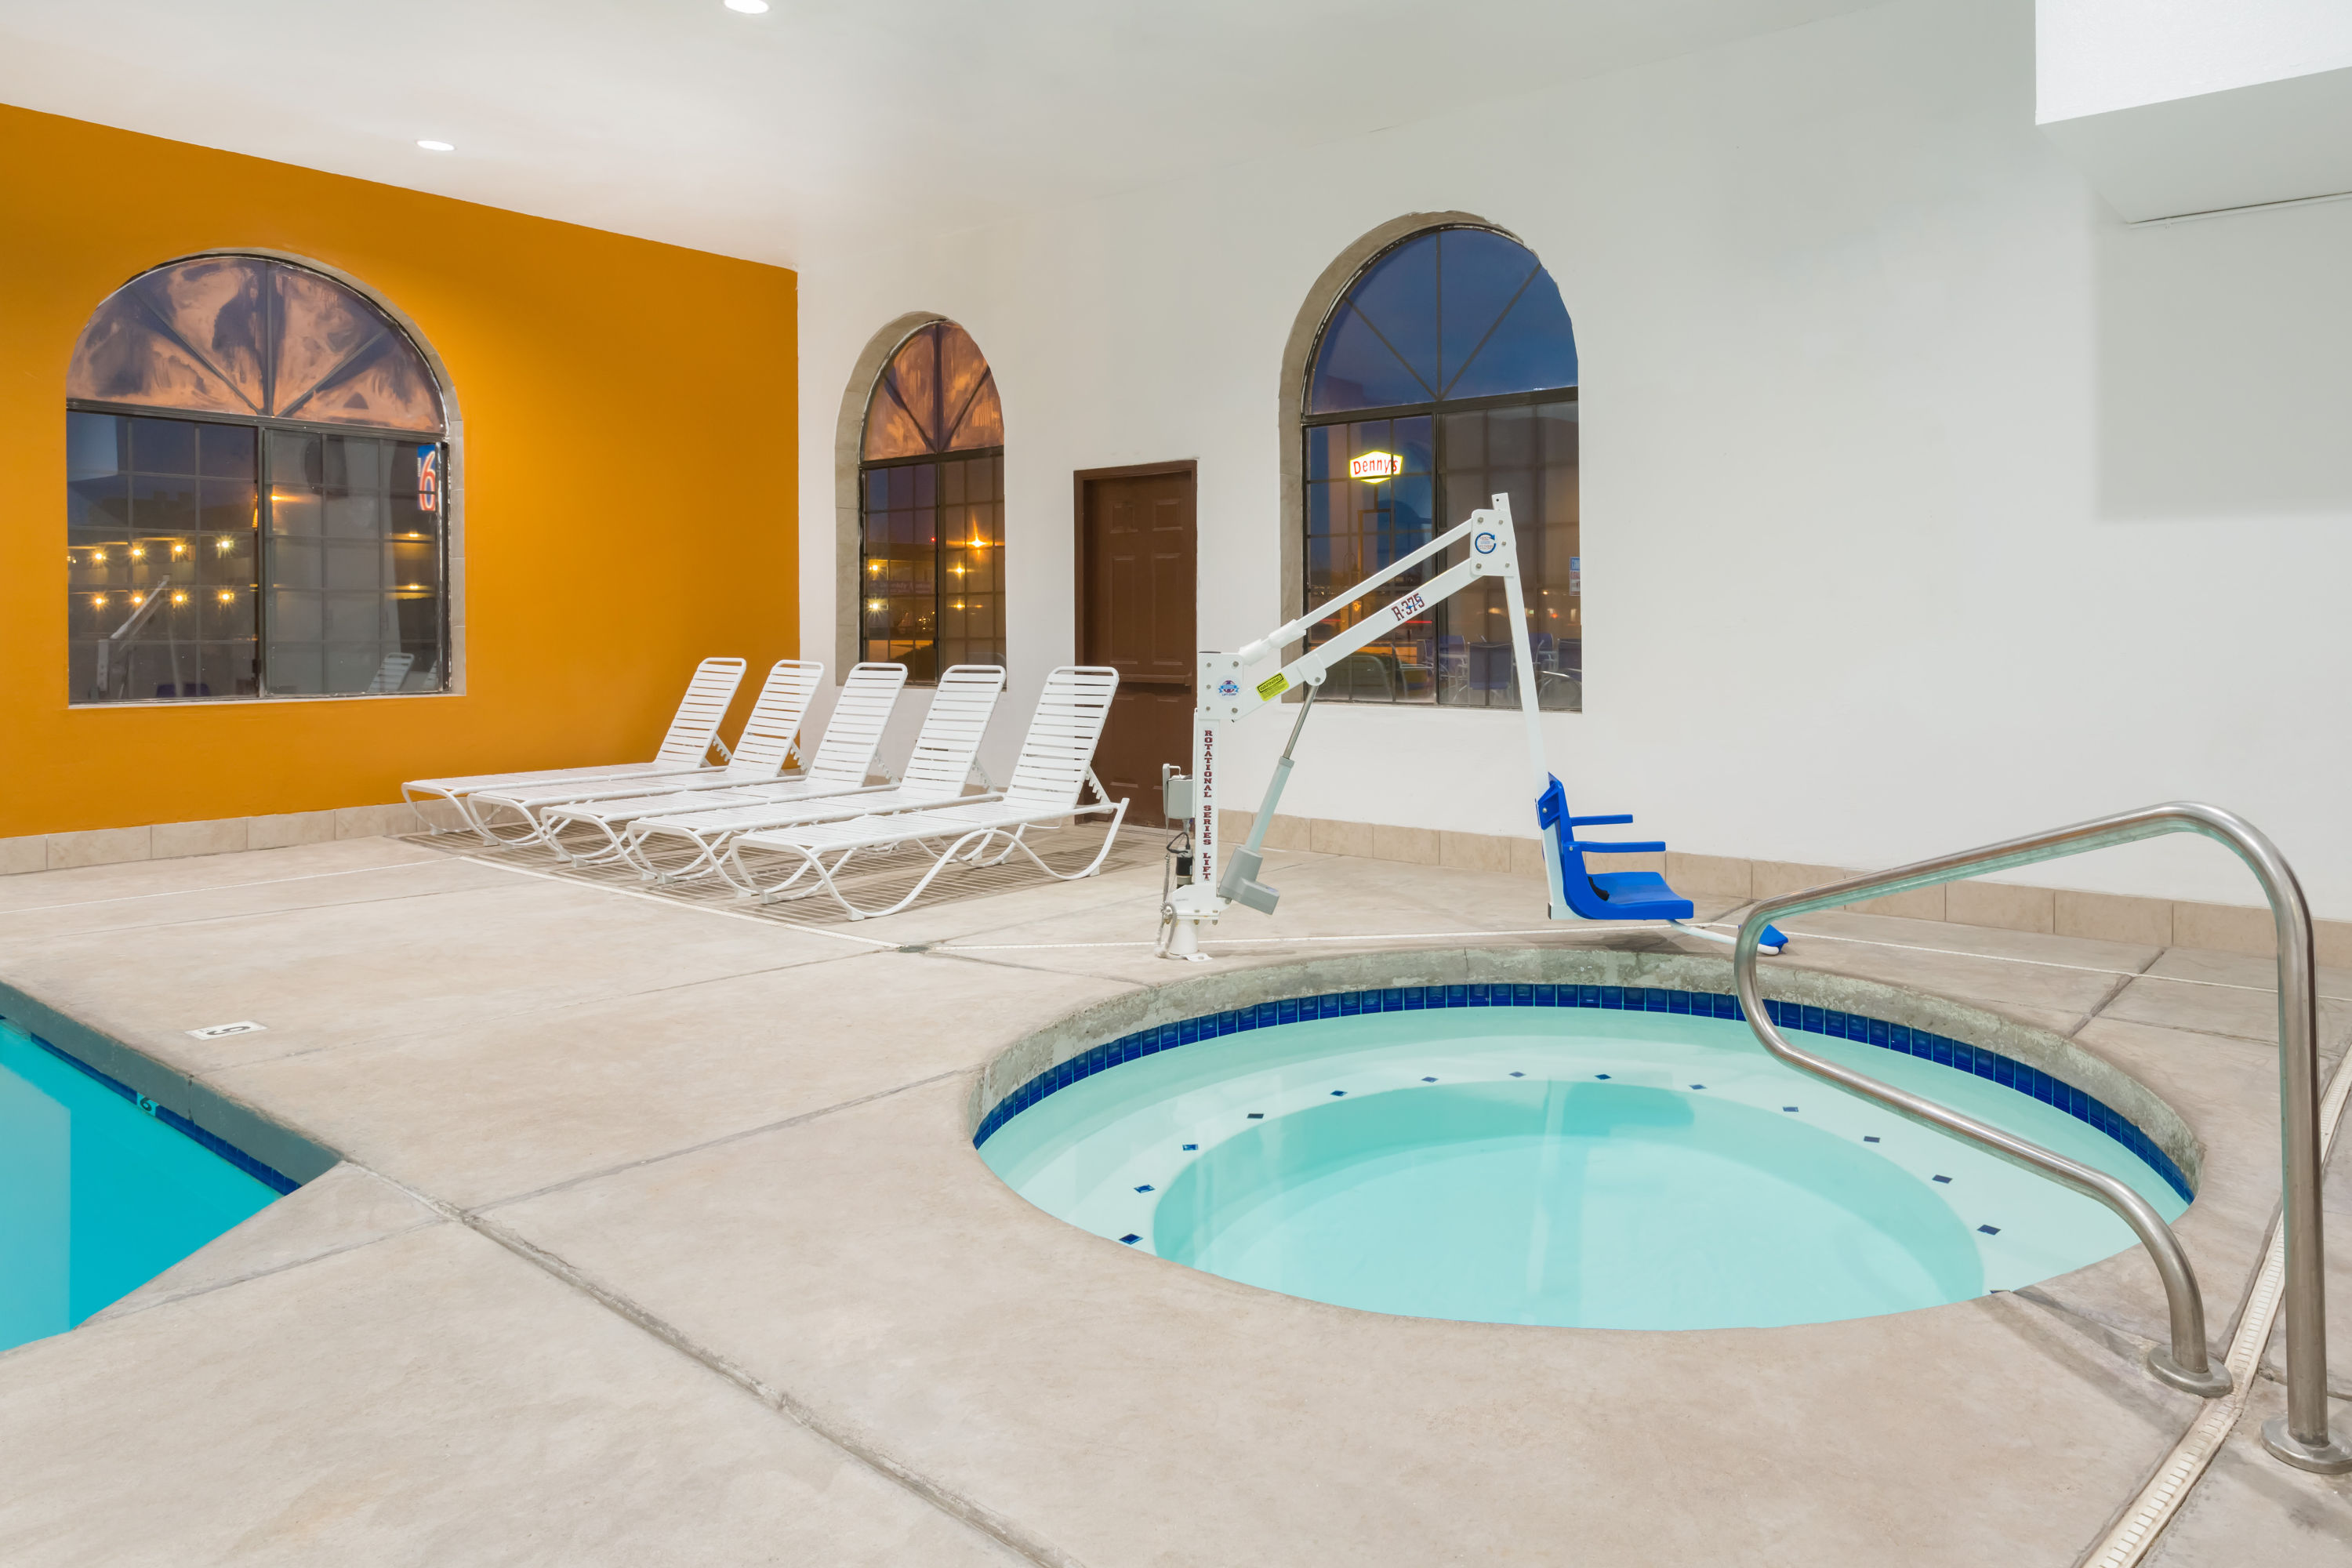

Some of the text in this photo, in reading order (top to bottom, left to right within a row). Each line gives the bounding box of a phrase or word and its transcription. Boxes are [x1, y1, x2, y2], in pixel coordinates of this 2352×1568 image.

[419, 451, 436, 511] 6
[1353, 459, 1398, 475] Dennys
[1392, 593, 1425, 621] R-375
[1203, 730, 1213, 797] ROTATIONAL
[1203, 805, 1211, 845] SERIES
[140, 1098, 152, 1112] 6
